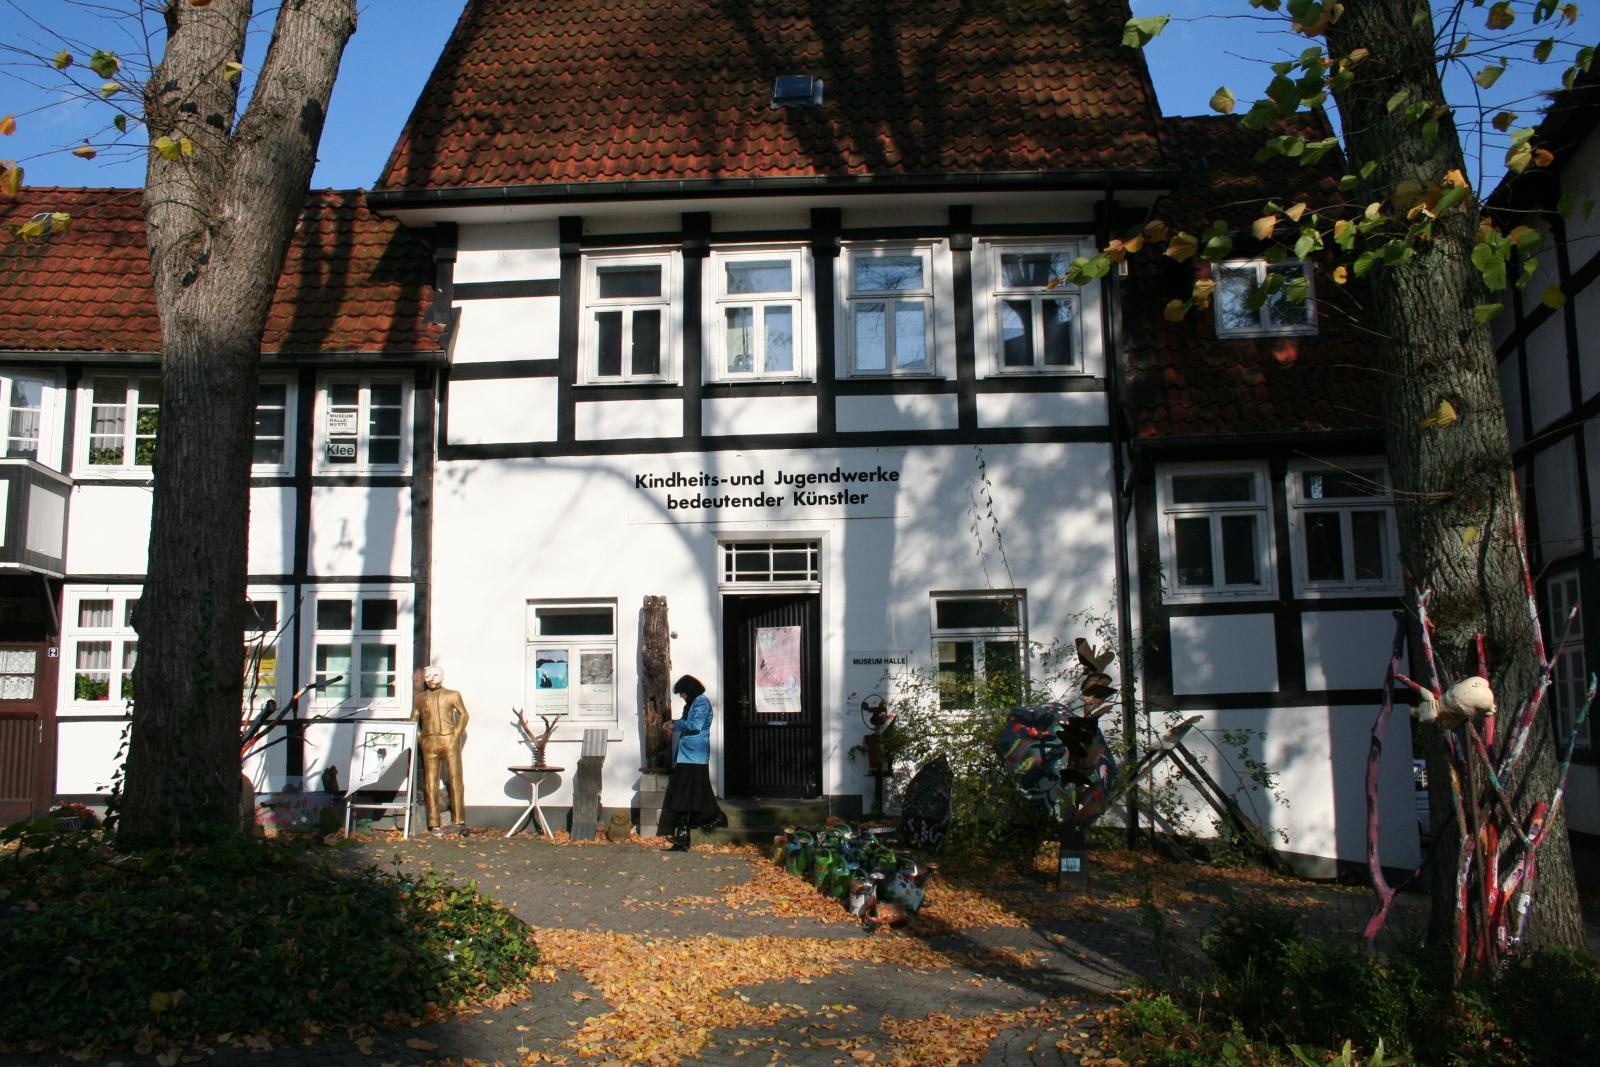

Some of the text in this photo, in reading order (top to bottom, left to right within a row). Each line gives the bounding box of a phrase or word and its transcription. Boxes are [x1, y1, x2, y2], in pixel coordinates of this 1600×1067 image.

[327, 444, 354, 456] Klee
[774, 466, 900, 489] Jugendwerke
[667, 489, 869, 510] bedeutender Künstler
[853, 657, 906, 665] MUSEUM HALLE
